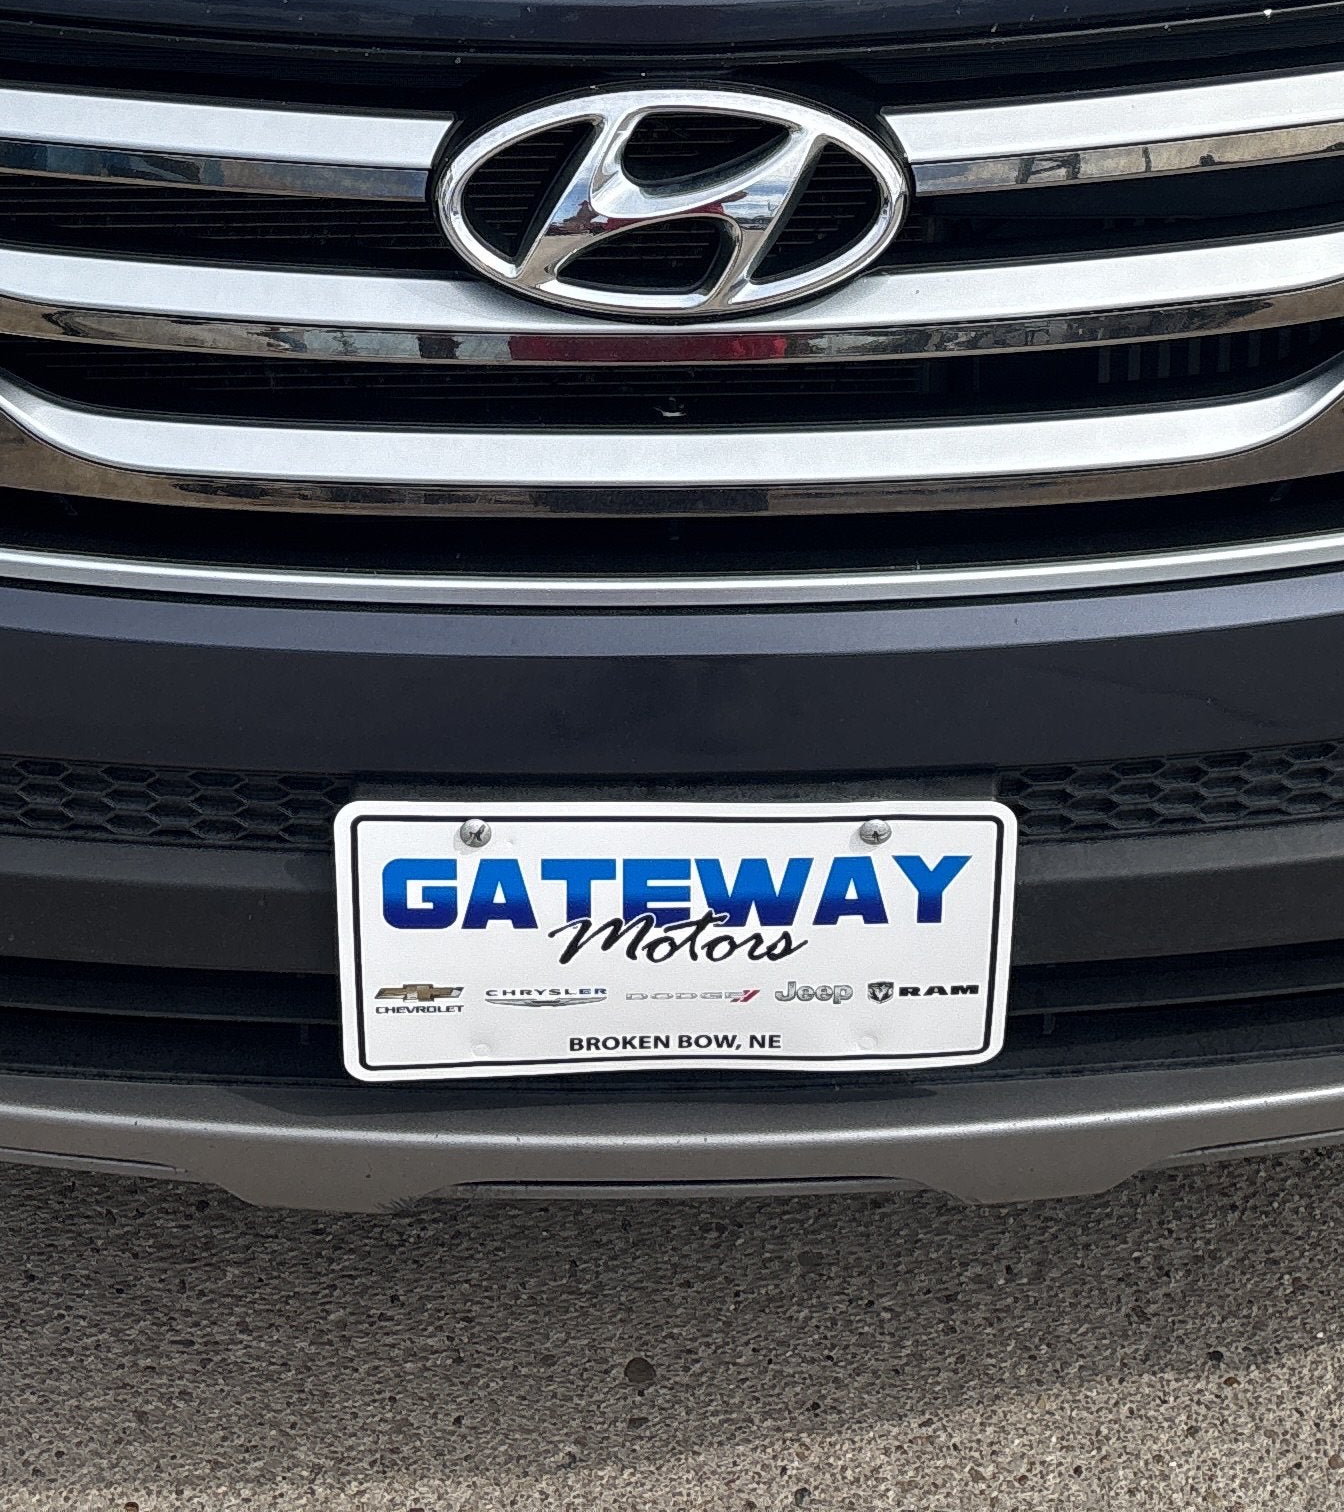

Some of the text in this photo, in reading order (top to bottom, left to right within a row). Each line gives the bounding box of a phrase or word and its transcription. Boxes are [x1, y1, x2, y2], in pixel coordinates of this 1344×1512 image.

[382, 855, 973, 930] GATEWAY
[547, 909, 809, 965] Motors
[485, 987, 607, 998] CHRYSLER
[625, 991, 746, 1000] DODGE
[774, 981, 854, 1005] Jeep
[898, 984, 980, 997] RAM
[375, 1004, 465, 1014] CHEVROLET
[569, 1034, 782, 1052] BROKEN BOW, NE
